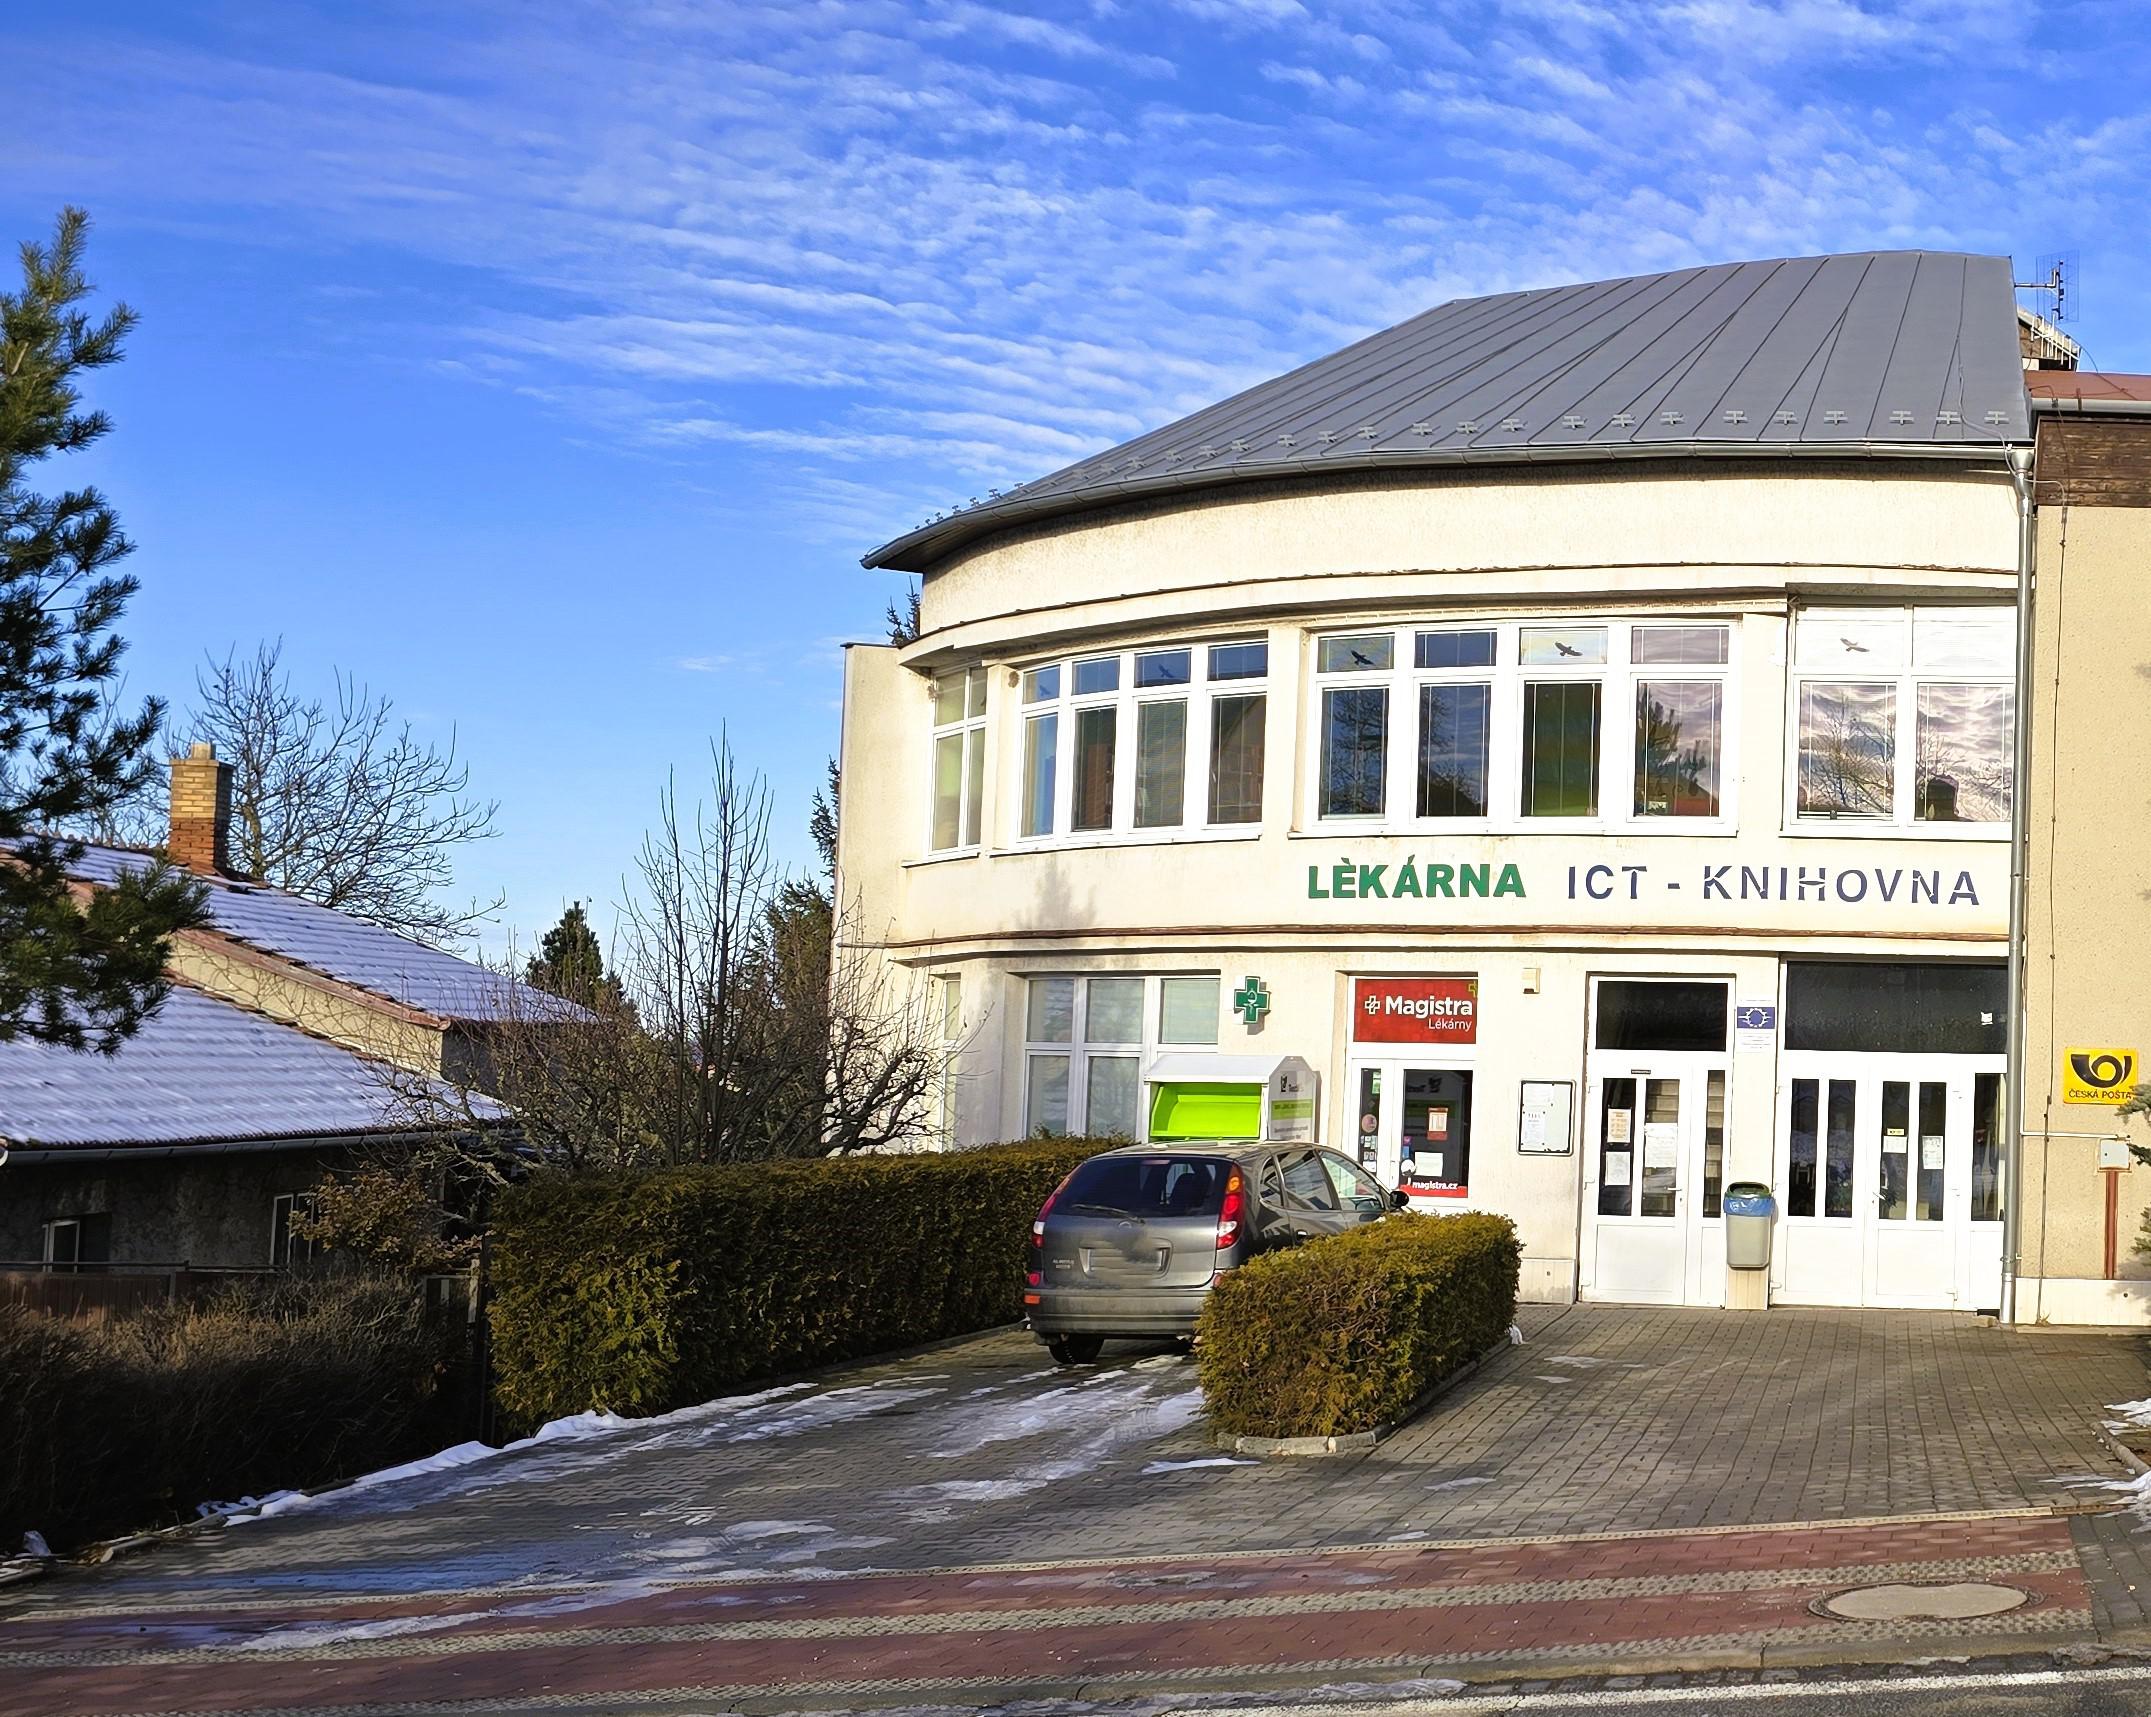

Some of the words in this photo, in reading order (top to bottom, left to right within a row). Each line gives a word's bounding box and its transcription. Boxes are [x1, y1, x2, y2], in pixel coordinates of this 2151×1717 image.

[1568, 865, 1648, 900] ICT
[1703, 865, 1980, 906] KNIHOVNA
[1385, 995, 1473, 1019] Magistra
[1428, 1018, 1473, 1032] Lékárny
[2068, 1088, 2099, 1099] ČESKÁ
[2101, 1089, 2132, 1100] POŠTA
[1412, 1180, 1459, 1191] magistra.cz
